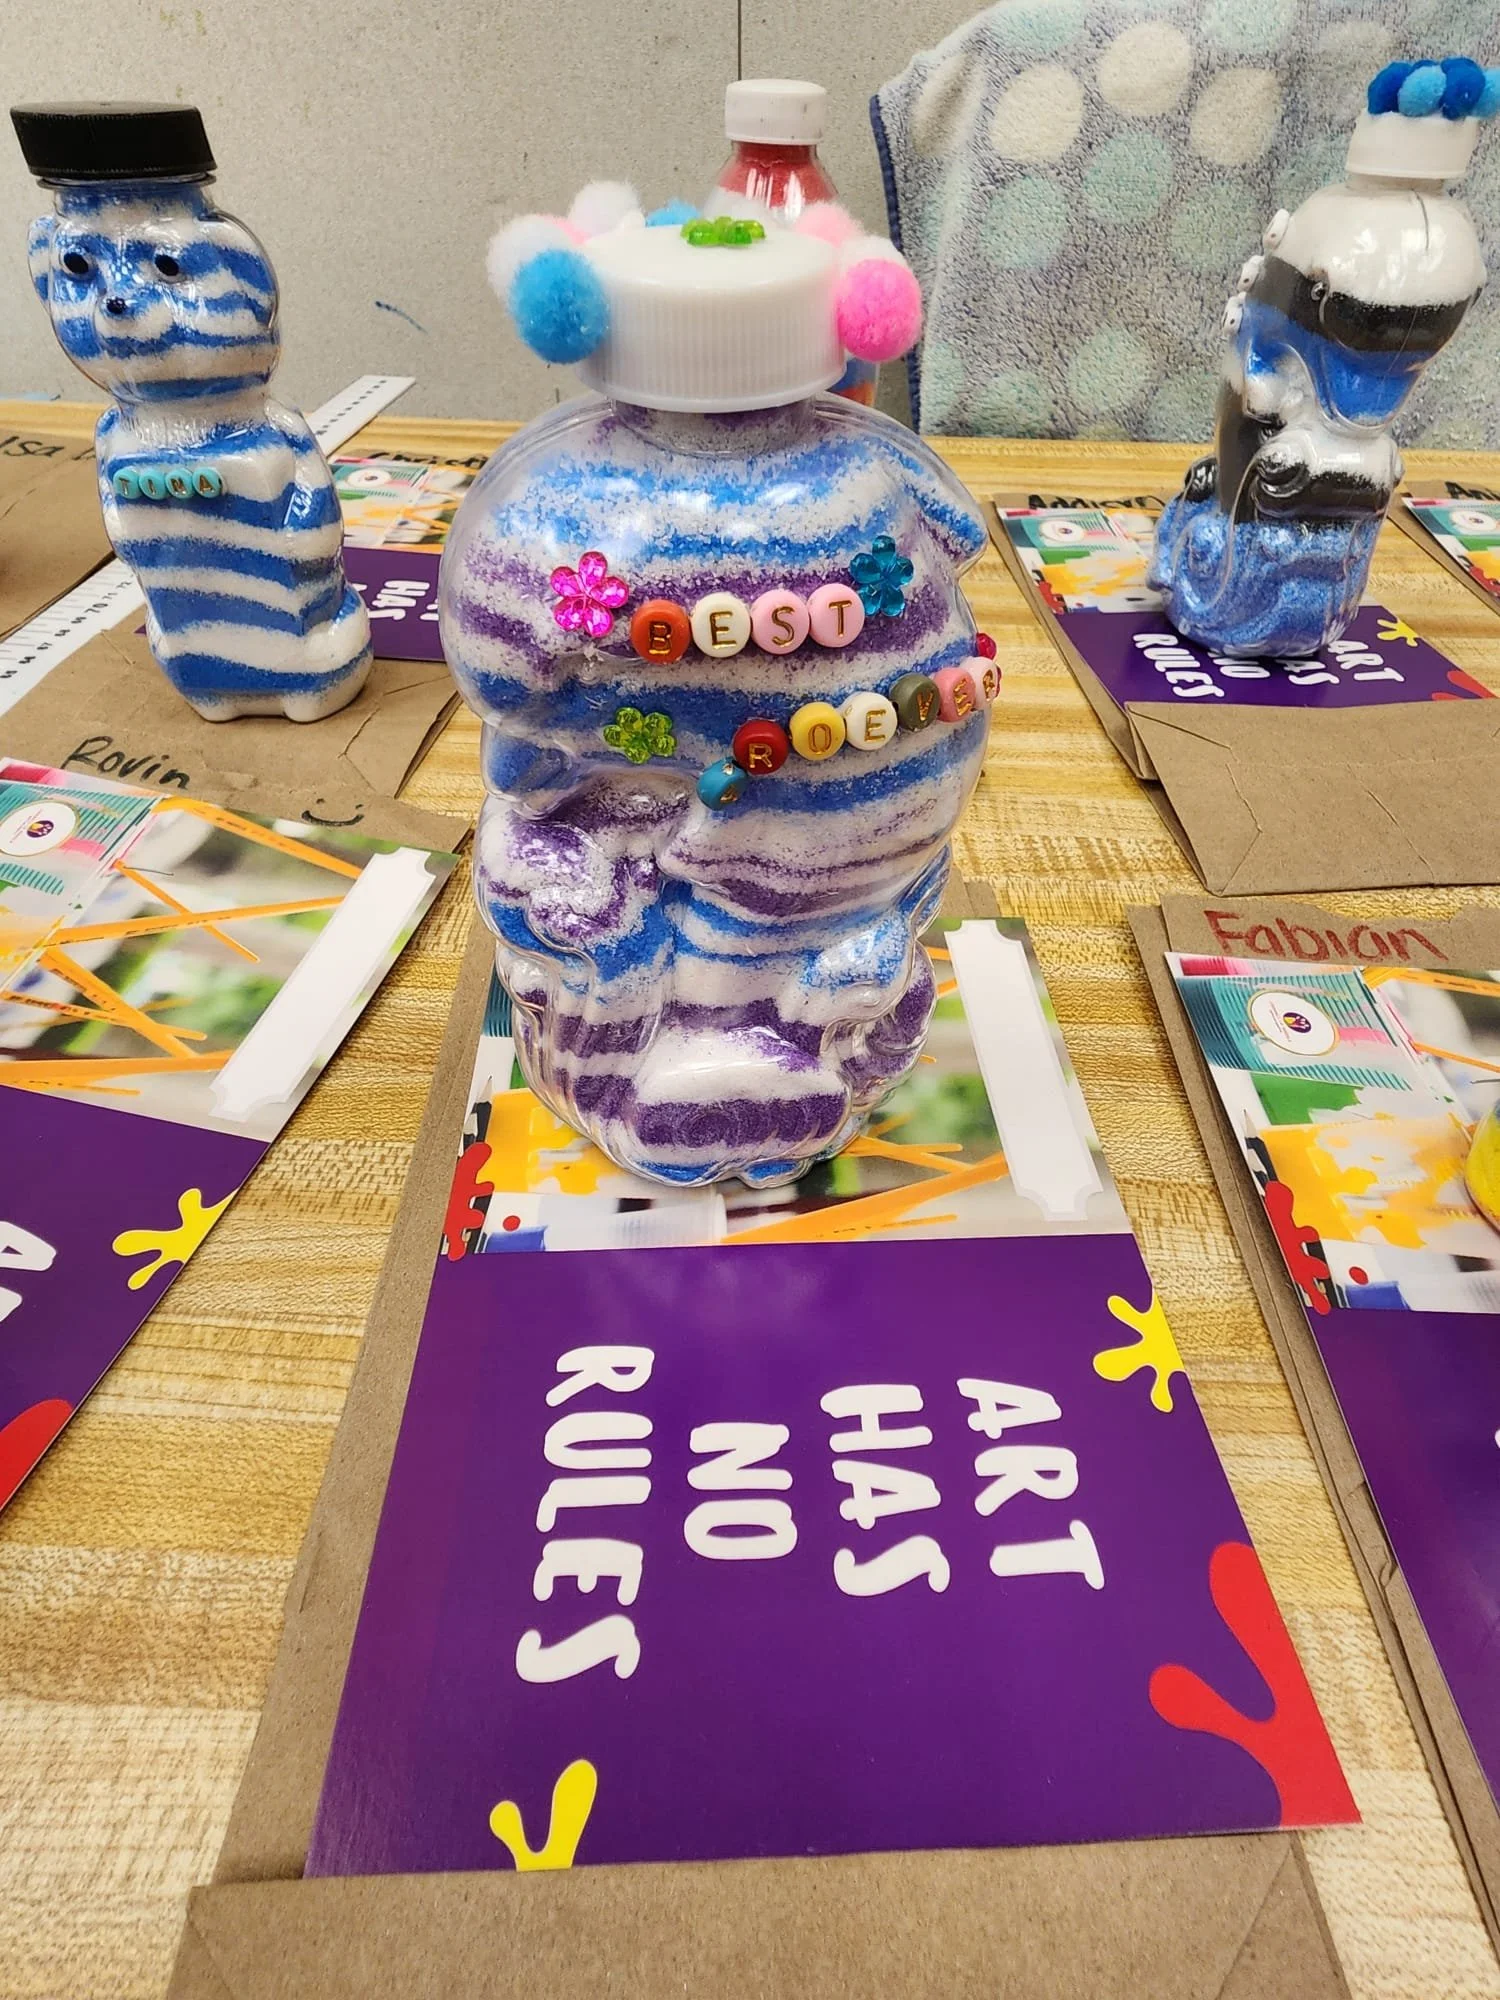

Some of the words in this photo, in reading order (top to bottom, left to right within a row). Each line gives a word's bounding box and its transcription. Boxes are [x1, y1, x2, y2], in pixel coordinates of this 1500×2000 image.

[118, 473, 217, 497] TINA
[647, 598, 853, 656] BEST
[1133, 633, 1225, 698] RULES
[1275, 658, 1340, 685] AS
[1328, 640, 1405, 682] ART
[1203, 909, 1449, 962] Fabian
[515, 1345, 655, 1684] RULES
[684, 1422, 798, 1560] NO
[820, 1384, 950, 1596] HAS
[956, 1378, 1105, 1590] ART
